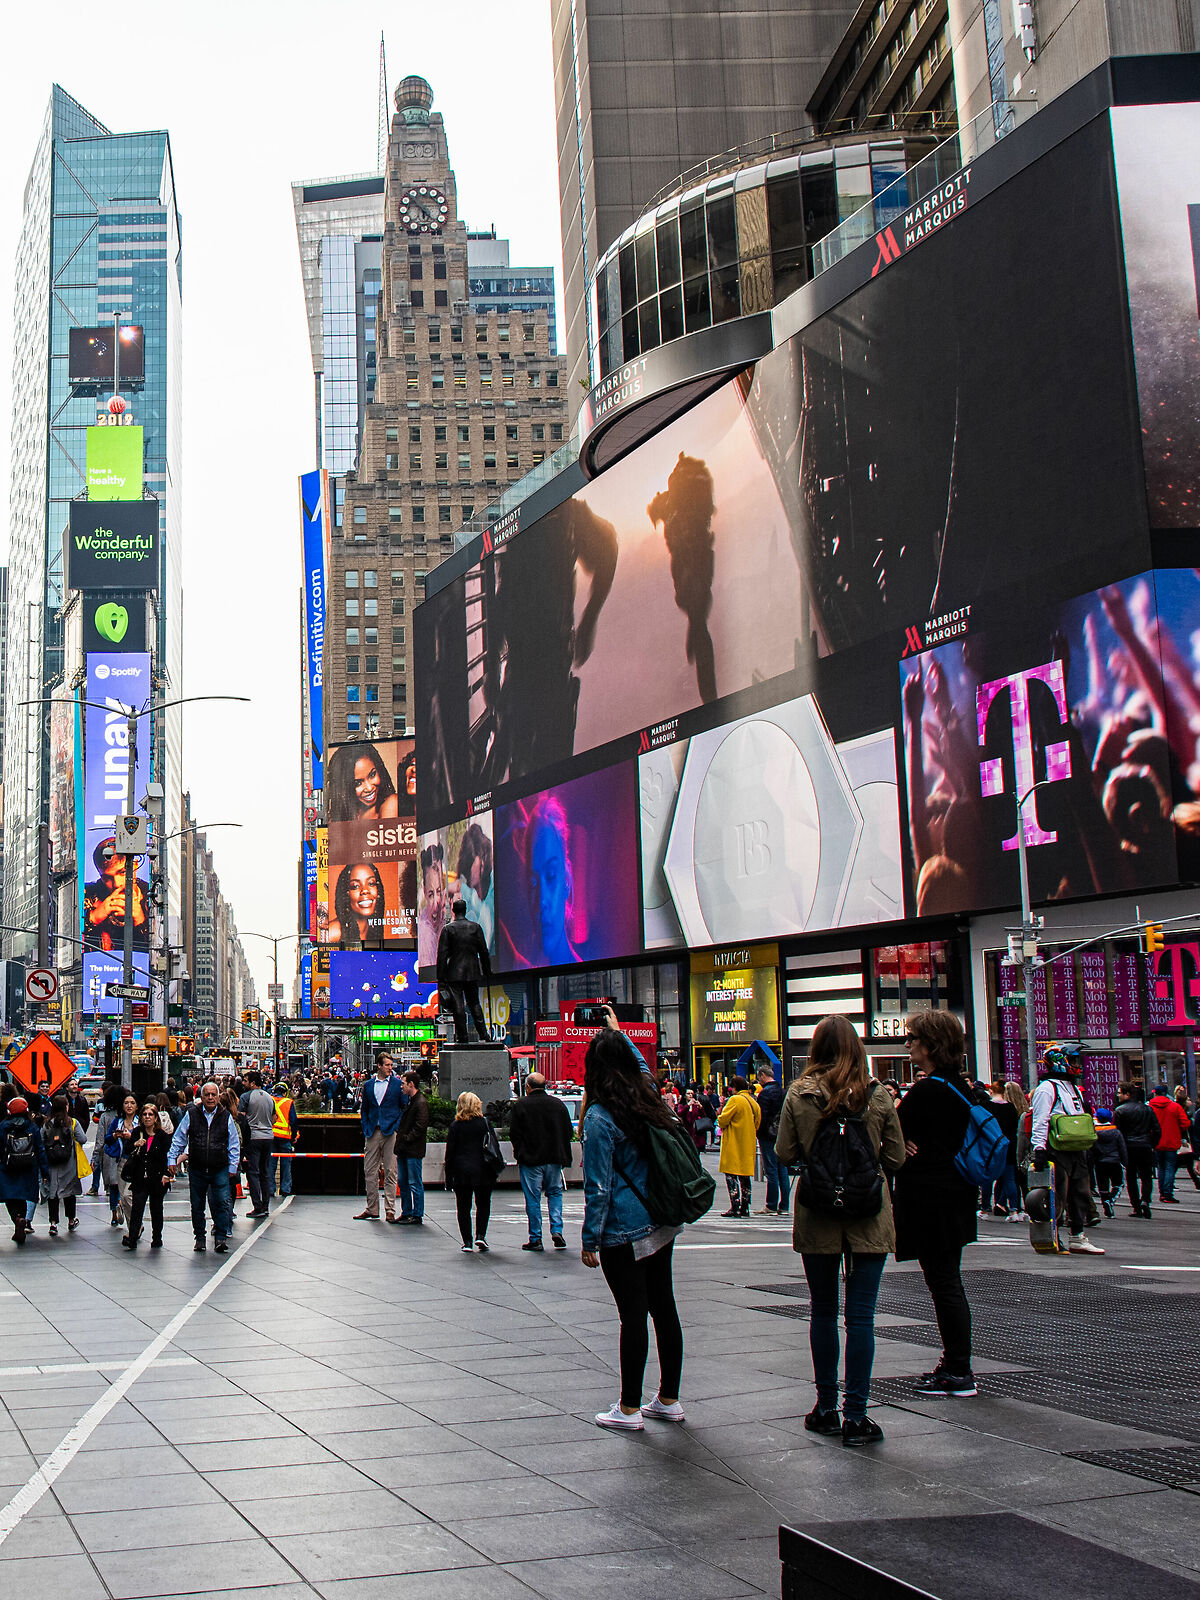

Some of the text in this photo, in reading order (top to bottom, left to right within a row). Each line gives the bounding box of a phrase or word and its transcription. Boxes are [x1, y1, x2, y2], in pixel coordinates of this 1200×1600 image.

[904, 168, 973, 229] MARRIOTT
[905, 193, 967, 248] MARQUIS
[595, 357, 648, 401] MARRIOTT
[596, 379, 642, 418] MARQUIS
[97, 413, 134, 427] 2019
[89, 467, 104, 475] Have
[89, 475, 126, 488] healthy
[494, 506, 522, 534] MARRIOTT
[94, 526, 113, 538] the
[494, 522, 519, 546] MARQUIS
[75, 535, 153, 550] Wonderful
[925, 605, 972, 631] MARRIOTT
[311, 568, 324, 687] Refinitiv.com
[926, 621, 968, 645] MARQUIS
[111, 667, 143, 680] Spotify
[651, 719, 679, 736] MARRIOTT
[652, 730, 676, 747] MARQUIS
[94, 696, 131, 826] Lunay
[976, 659, 1072, 852] T
[366, 824, 417, 846] sista
[362, 848, 417, 858] SINGLE BUT NEVER
[386, 908, 416, 917] ALL NEW
[367, 917, 412, 926] WEDNESDAYS
[714, 950, 752, 966] INVICTA
[89, 964, 120, 972] The New
[713, 978, 744, 991] 12-MONTH
[1153, 942, 1200, 1026] T
[111, 987, 145, 997] ONE WAY
[706, 988, 753, 1002] INTEREST-FREE
[1004, 997, 1020, 1006] W 46
[714, 1010, 747, 1022] FINANCING
[538, 1027, 558, 1036] COFFEED
[628, 1029, 654, 1038] CHURROS
[714, 1021, 747, 1032] AVAILABLE
